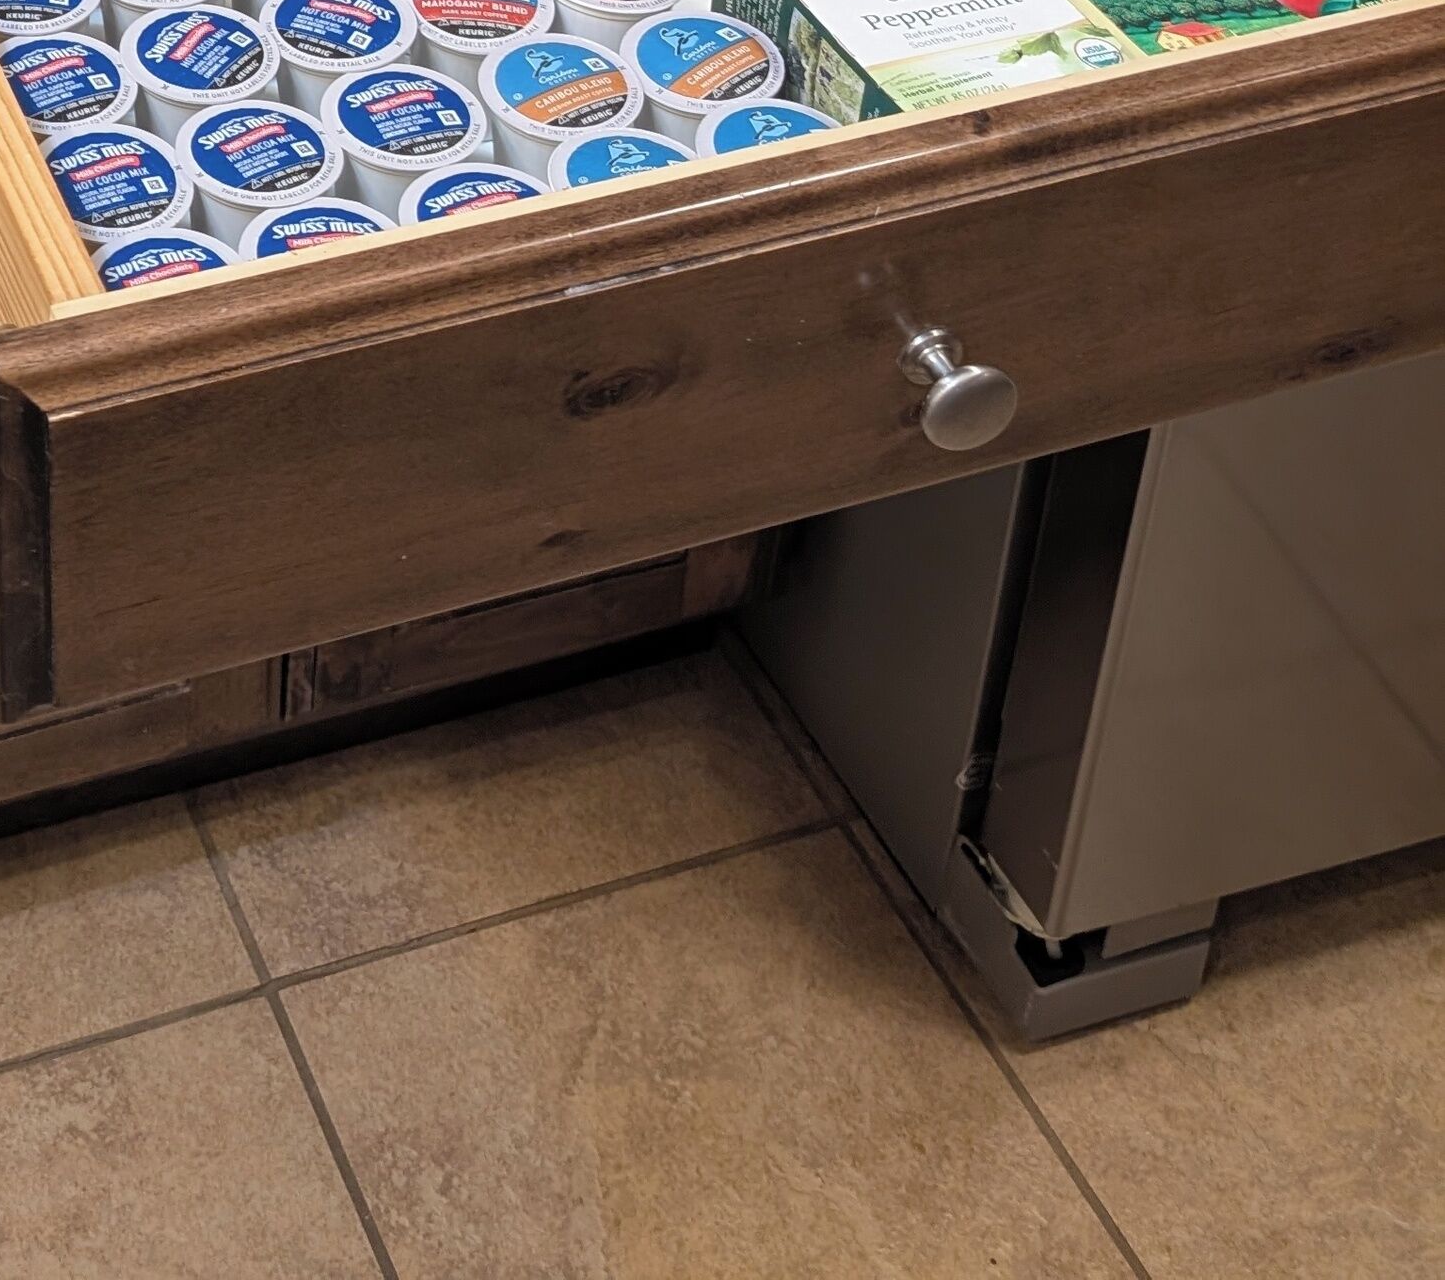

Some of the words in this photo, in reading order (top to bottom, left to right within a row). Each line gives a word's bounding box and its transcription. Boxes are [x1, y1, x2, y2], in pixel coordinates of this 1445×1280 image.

[6, 12, 42, 20] KEURIG
[300, 6, 320, 15] HOT
[321, 10, 350, 26] COCOA
[350, 20, 371, 33] MIX
[354, 0, 396, 21] MISS
[483, 11, 508, 19] COFFEE
[492, 3, 528, 15] BLEND
[145, 31, 181, 63] SWISS
[180, 12, 210, 34] MISS
[459, 28, 496, 37] KEURIG
[903, 23, 965, 41] Refreshing
[966, 20, 976, 32] &
[977, 15, 1009, 28] Minty
[908, 34, 956, 49] Soothes
[959, 27, 986, 40] Your
[47, 45, 89, 60] MISS
[180, 49, 197, 68] HOT
[194, 36, 215, 56] COCOA
[214, 28, 231, 40] MIX
[298, 42, 334, 57] KEURIG
[682, 40, 716, 61] Caribou
[1083, 44, 1106, 55] USDA
[235, 60, 259, 81] KEURIG
[539, 68, 578, 84] Caribou
[686, 58, 723, 85] CARIBOU
[723, 45, 751, 63] BLEND
[23, 80, 43, 92] HOT
[45, 71, 74, 85] COCOA
[74, 66, 95, 76] MIX
[734, 76, 762, 95] KEURIG
[902, 85, 936, 98] Herbal
[936, 71, 993, 90] Supplement
[346, 86, 396, 108] SWISS
[395, 80, 439, 93] MISS
[534, 87, 579, 109] CARIBOU
[579, 76, 612, 90] BLEND
[547, 101, 572, 113] MEDIUM
[572, 93, 591, 104] ROAST
[591, 87, 614, 96] COFFEE
[66, 104, 100, 120] KEURIG
[369, 113, 390, 123] HOT
[392, 105, 424, 117] COCOA
[424, 101, 445, 110] MIX
[581, 109, 613, 125] KEURIG
[198, 124, 247, 150] SWISS
[244, 113, 287, 129] MISS
[100, 141, 146, 158] MISS
[226, 149, 247, 162] HOT
[248, 139, 275, 154] COCOA
[276, 134, 297, 144] MIX
[73, 180, 93, 193] HOT
[95, 172, 129, 187] COCOA
[129, 167, 150, 177] MIX
[425, 187, 477, 213] SWISS
[476, 180, 522, 195] MISS
[272, 222, 327, 239] SWISS
[104, 256, 159, 283] SWISS
[160, 248, 207, 263] MISS
[129, 276, 147, 287] Milk
[148, 264, 195, 282] Chocolate
